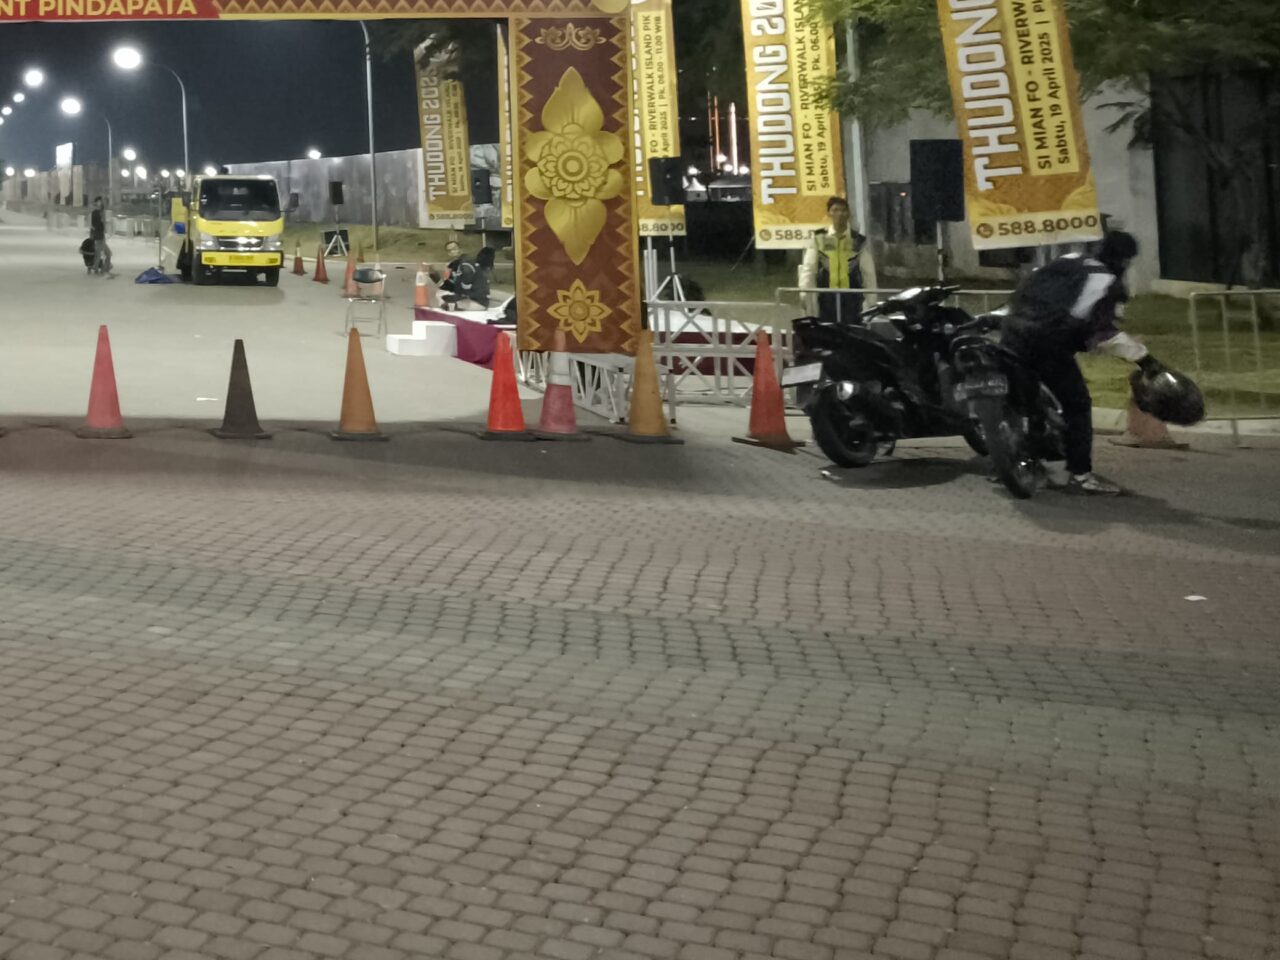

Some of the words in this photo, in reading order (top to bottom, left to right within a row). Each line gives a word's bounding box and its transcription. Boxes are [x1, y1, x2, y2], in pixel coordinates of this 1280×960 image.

[642, 15, 651, 31] PIK
[644, 34, 654, 70] ISLAND
[1038, 32, 1054, 63] 2025
[795, 35, 810, 110] RIVERWALK
[1042, 68, 1063, 100] April
[646, 72, 657, 130] RIVERWALK
[1025, 80, 1041, 103] FO
[1049, 103, 1062, 117] 19
[753, 44, 797, 205] THUDONG
[802, 122, 812, 139] FO
[815, 114, 827, 135] April
[1030, 107, 1048, 150] MIAN
[650, 140, 658, 153] FO
[661, 133, 670, 152] April
[817, 141, 827, 153] 19
[1055, 120, 1070, 164] Sabtu,
[423, 114, 447, 201] THUDONG
[803, 143, 815, 175] MIAN
[1038, 155, 1052, 170] SI
[819, 154, 830, 189] Sabtu,
[807, 180, 816, 192] SI
[998, 214, 1098, 236] 588.8000
